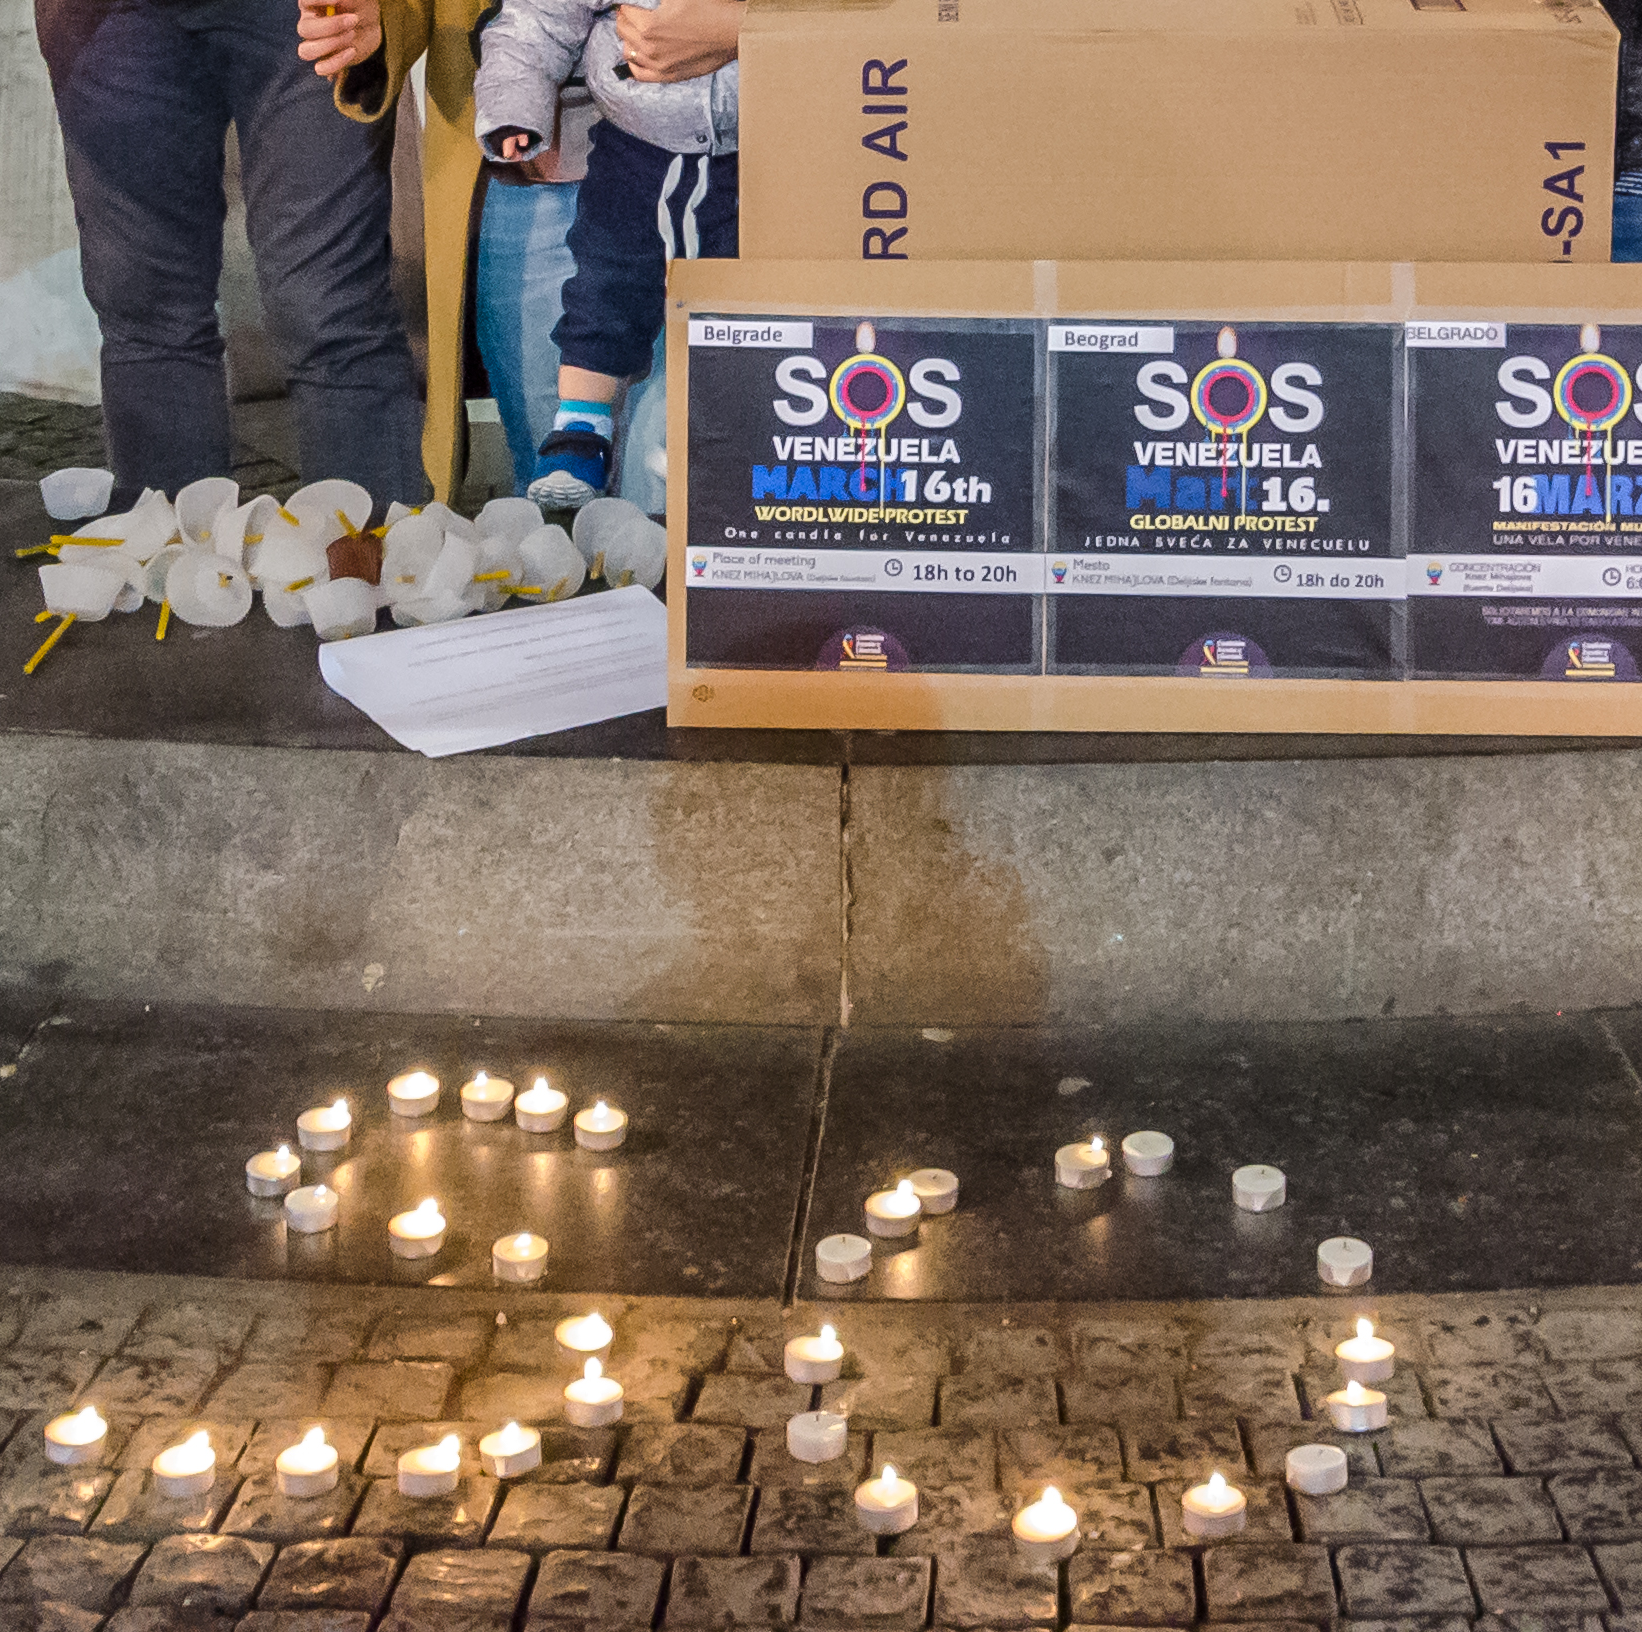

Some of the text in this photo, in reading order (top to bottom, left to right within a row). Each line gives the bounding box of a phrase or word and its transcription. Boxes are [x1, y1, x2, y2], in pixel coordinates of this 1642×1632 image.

[861, 58, 909, 162] AIR
[703, 325, 784, 346] Belgrade
[1064, 330, 1139, 352] Beograd
[1406, 326, 1499, 341] BELGRADO
[772, 353, 963, 429] SOS
[1133, 358, 1325, 434] SOS
[772, 435, 962, 464] VENEZUELA
[1133, 441, 1323, 469] VENEZUELA
[1126, 465, 1331, 513] Mart 16.
[754, 506, 970, 526] WORDLWIDE PROTEST
[1129, 514, 1319, 532] GLOBALNI PROTEST
[1084, 535, 1140, 549] JEDNA
[1226, 536, 1249, 550] ZA
[1492, 535, 1524, 546] UNA
[1528, 535, 1566, 546] VELA
[1569, 535, 1601, 546] POR
[913, 565, 1018, 583] 18h to 20h
[1296, 573, 1385, 588] 18h do 20h
